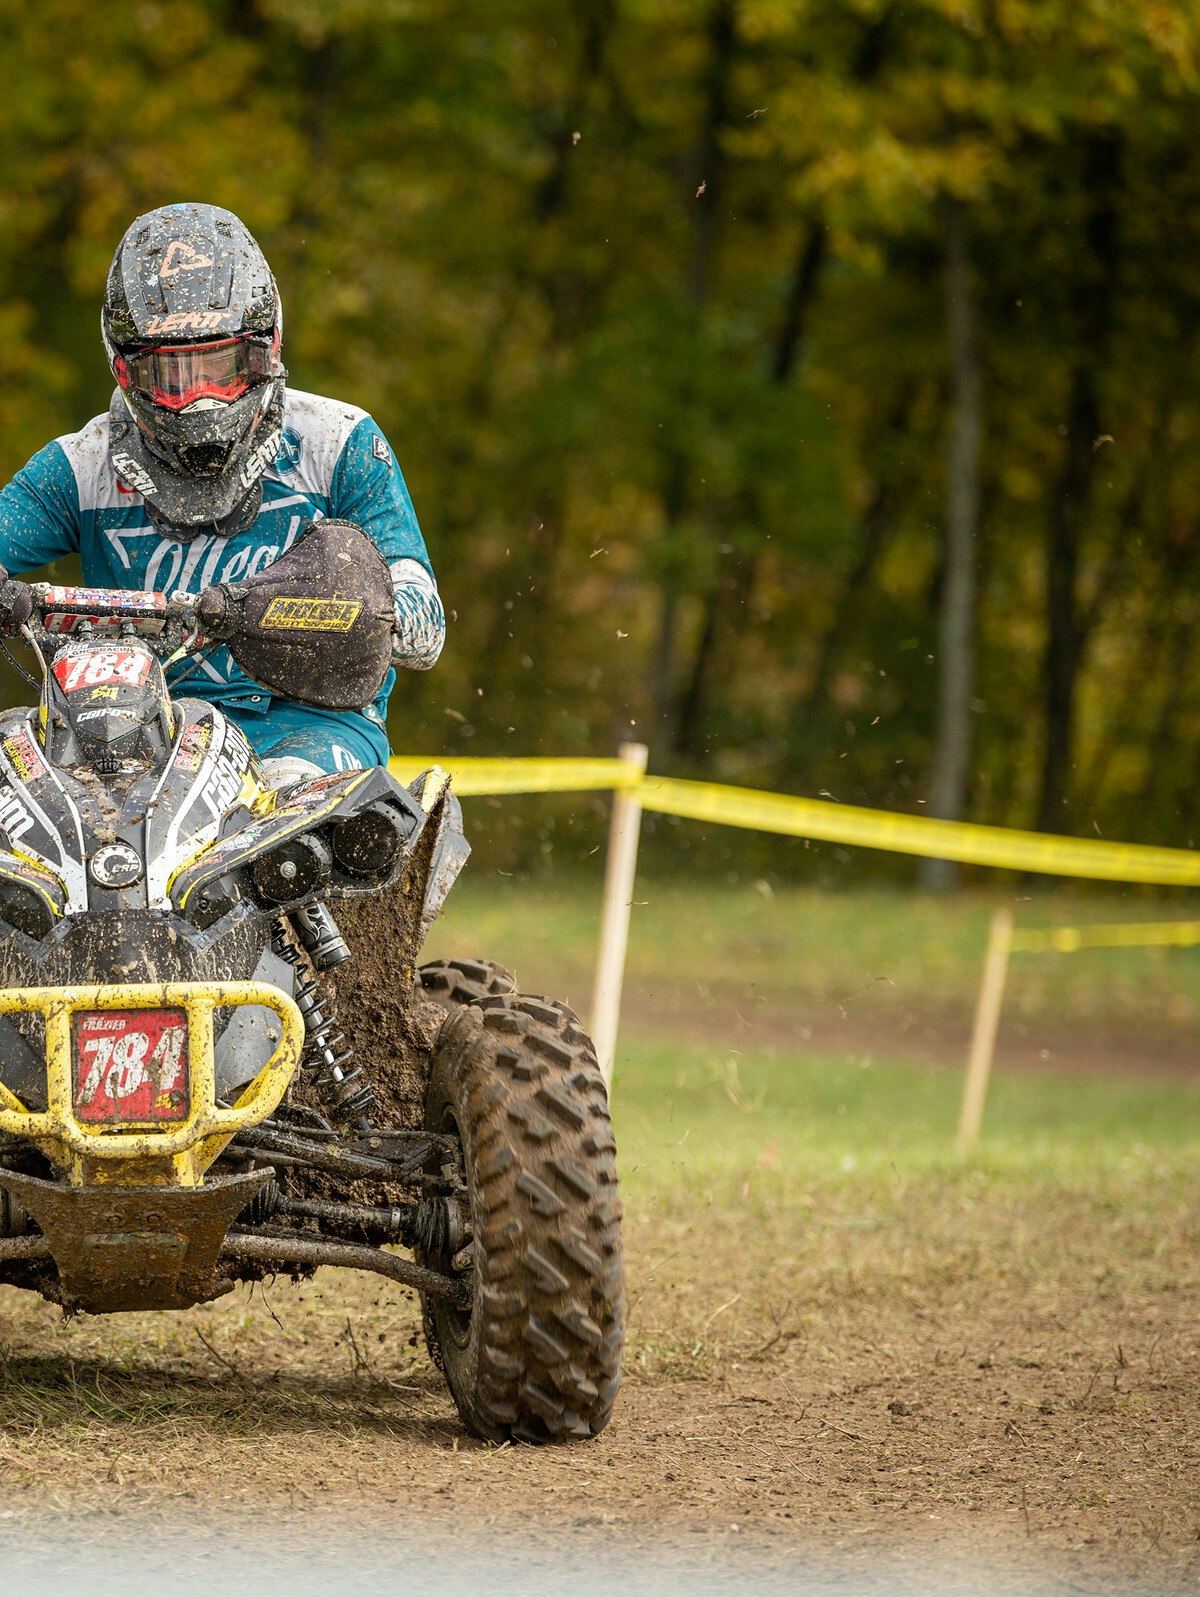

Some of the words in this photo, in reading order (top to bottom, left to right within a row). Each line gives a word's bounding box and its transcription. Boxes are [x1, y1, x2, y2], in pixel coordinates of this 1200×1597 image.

[146, 311, 232, 335] LEATT
[111, 452, 158, 496] LEATT
[240, 431, 282, 489] LEATT
[269, 599, 357, 621] MOOSE
[64, 652, 146, 690] 784
[75, 1024, 188, 1106] 784
